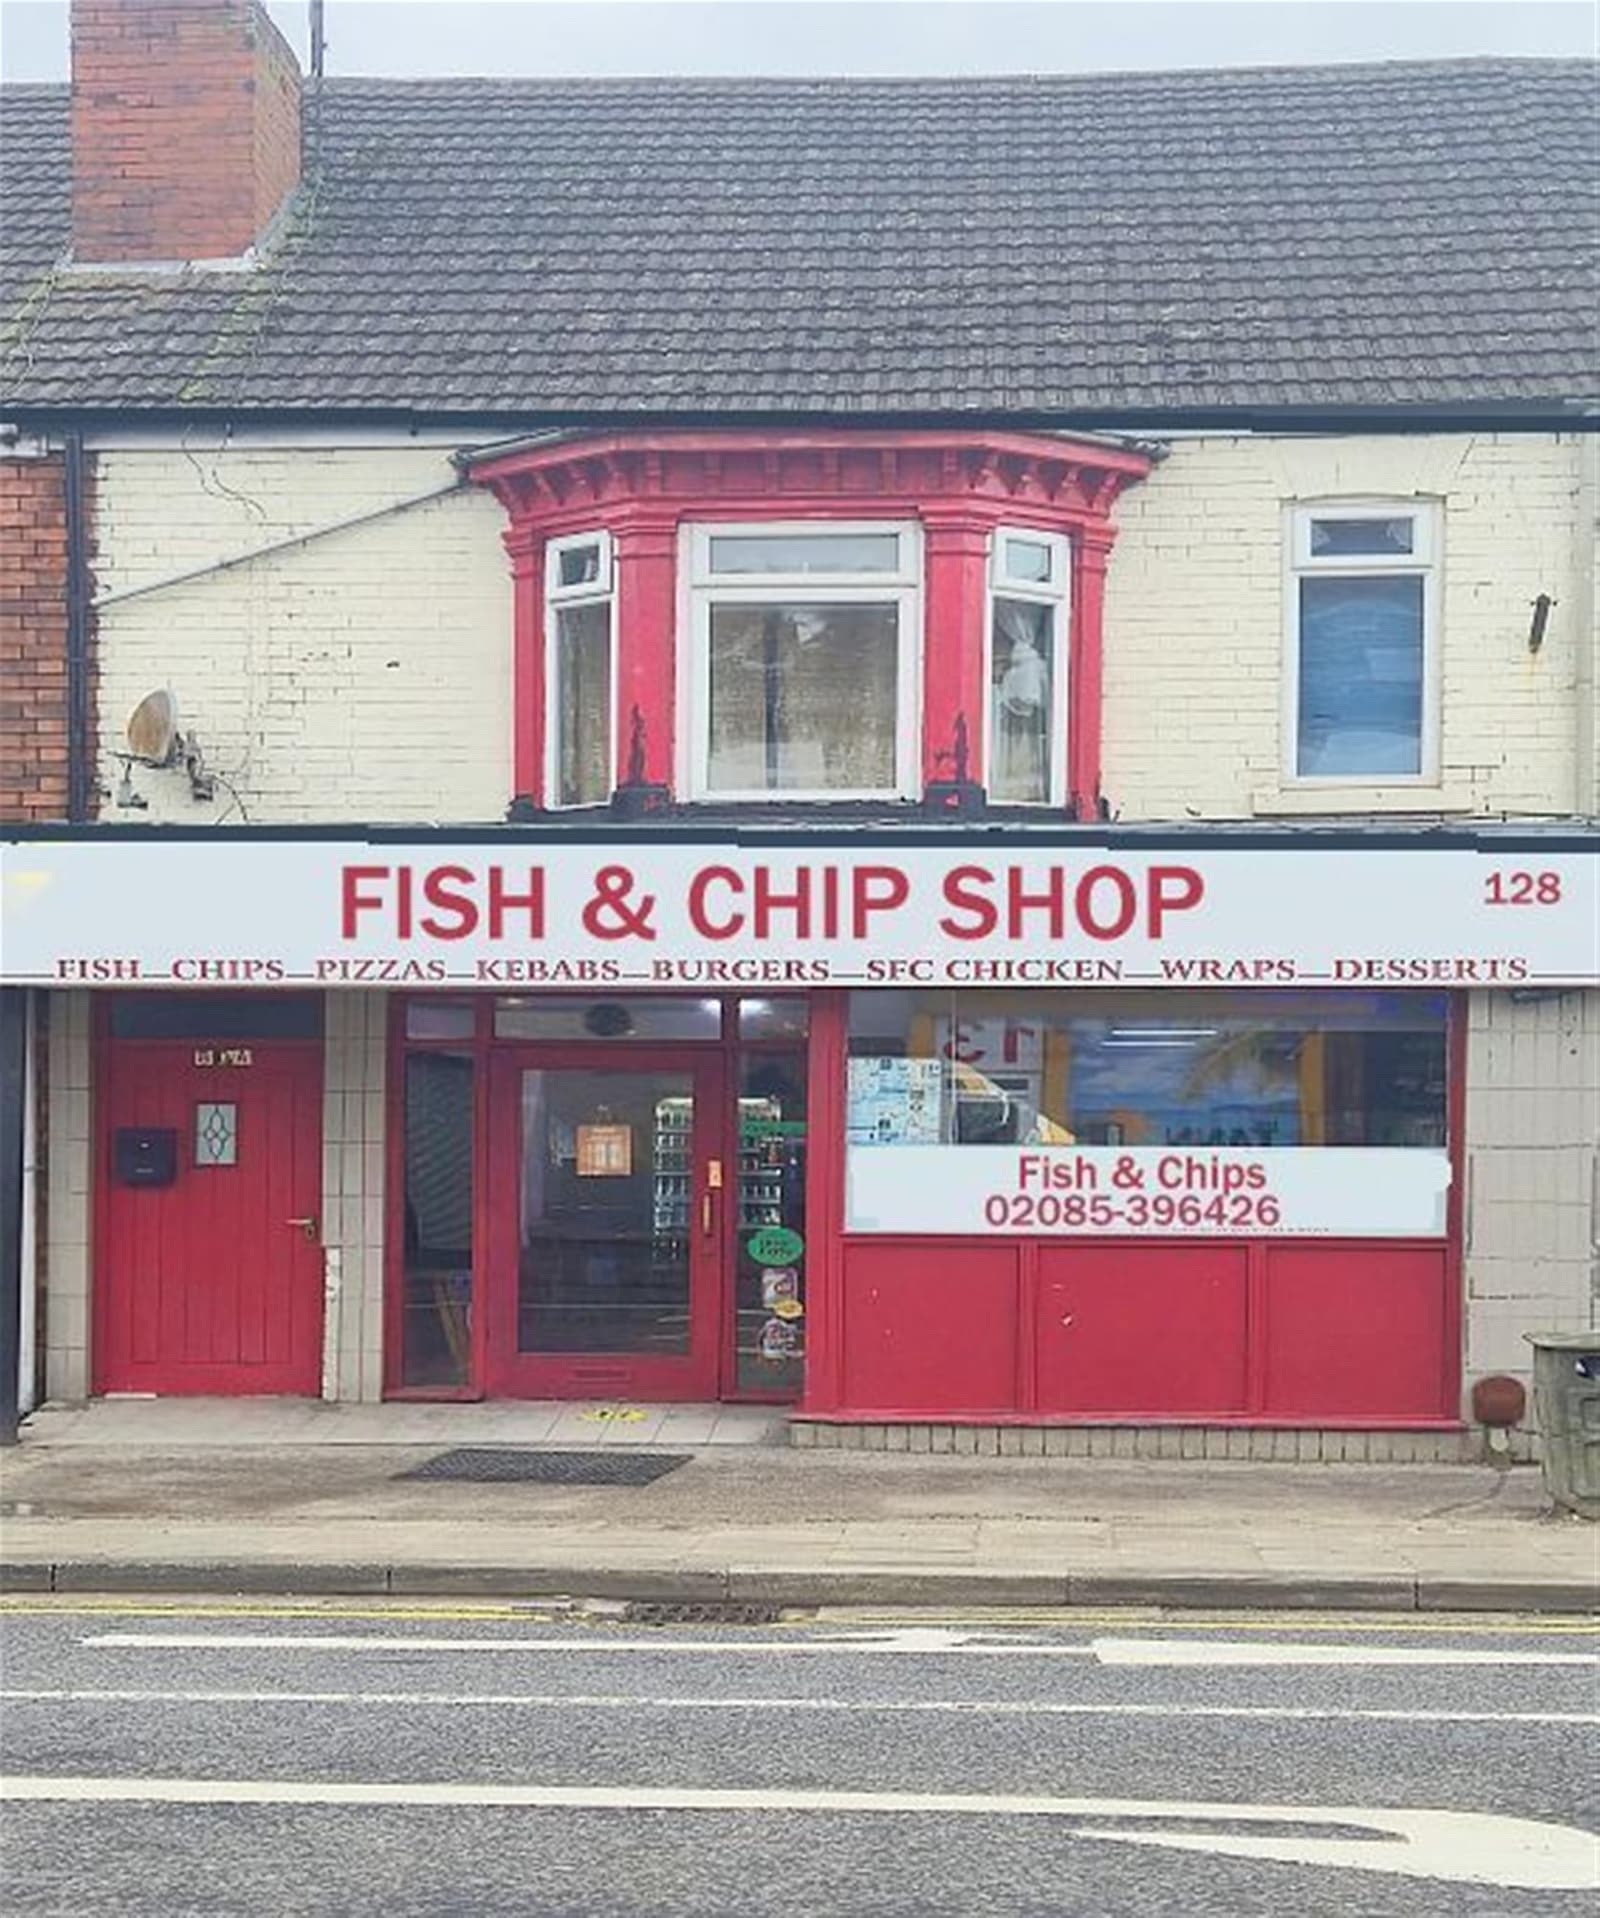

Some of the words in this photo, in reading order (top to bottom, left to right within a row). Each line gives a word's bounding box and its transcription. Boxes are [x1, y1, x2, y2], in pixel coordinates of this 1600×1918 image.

[341, 864, 546, 942] FISH
[581, 864, 657, 942] &
[687, 864, 911, 942] CHIP
[938, 864, 1205, 942] SHOP
[1483, 871, 1563, 906] 128
[57, 958, 140, 981] FISH
[171, 958, 284, 981] CHIPS
[315, 958, 446, 981] PIZZAS
[476, 958, 621, 981] KEBABS
[652, 958, 830, 981] BURGERS
[866, 958, 934, 981] SFC
[945, 958, 1123, 981] CHICKEN
[1159, 958, 1296, 981] WRAPS
[1333, 957, 1528, 981] DESSERTS
[1019, 1154, 1097, 1190] Fish
[1111, 1155, 1145, 1190] &
[1157, 1154, 1267, 1192] Chips
[985, 1192, 1280, 1227] 02085-396426
